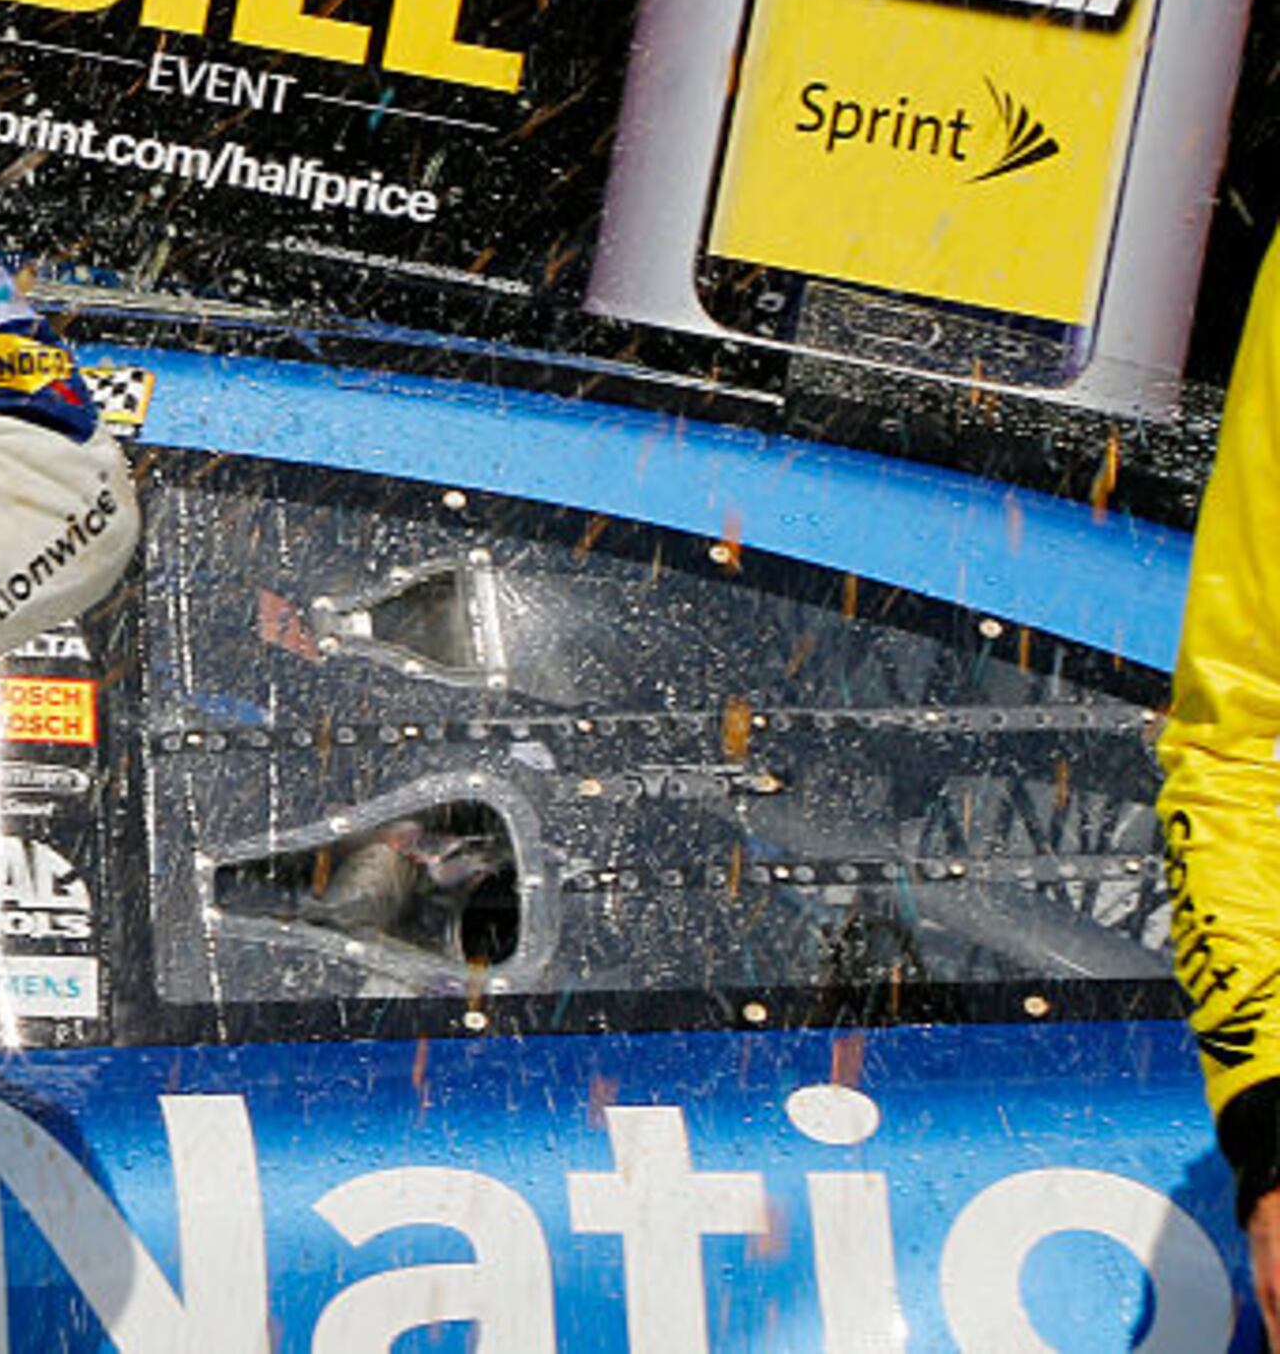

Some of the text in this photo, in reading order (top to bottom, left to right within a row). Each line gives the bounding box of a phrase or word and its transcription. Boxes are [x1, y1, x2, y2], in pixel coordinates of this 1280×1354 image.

[147, 53, 297, 115] EVENT
[796, 81, 973, 163] Sprint
[0, 714, 83, 736] OSCH
